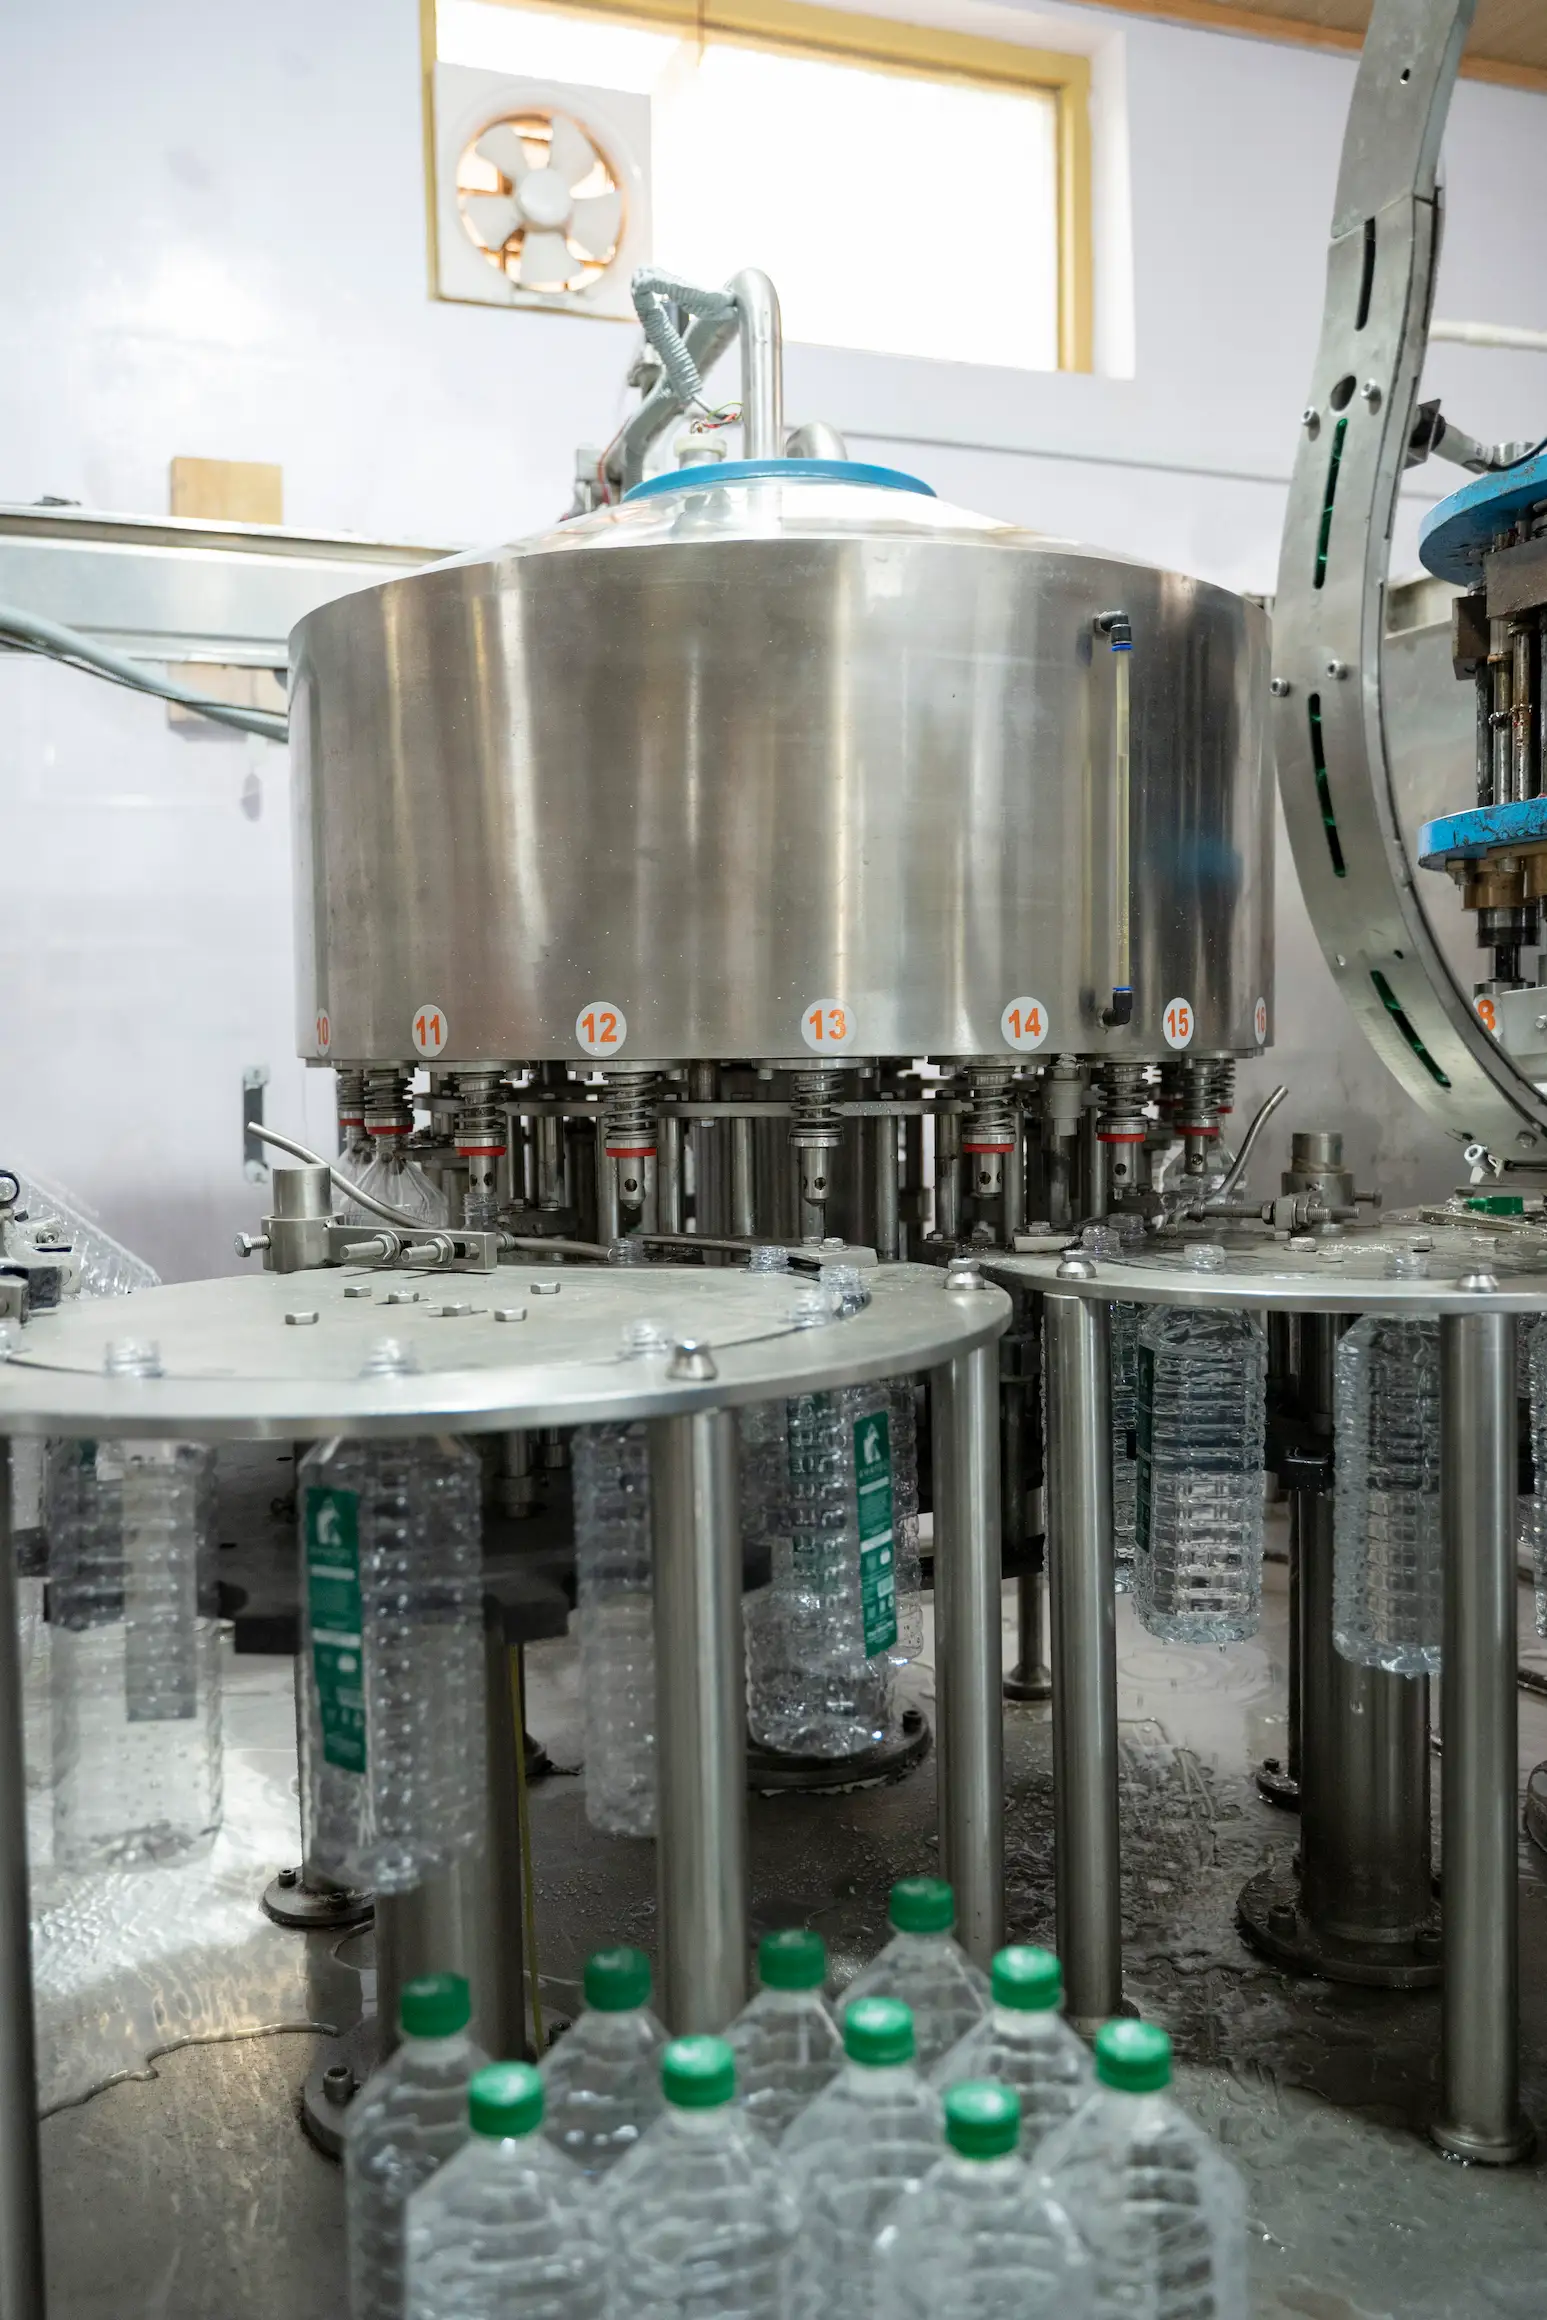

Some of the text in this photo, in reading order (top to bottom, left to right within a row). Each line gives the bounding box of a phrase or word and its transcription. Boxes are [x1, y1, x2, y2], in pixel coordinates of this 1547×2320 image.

[316, 1017, 329, 1045] 10
[416, 1014, 441, 1046] 11
[581, 1012, 617, 1043] 12
[808, 1009, 848, 1040] 13
[1007, 1008, 1042, 1038] 14
[1167, 1007, 1189, 1038] 15
[1256, 1007, 1266, 1033] 16
